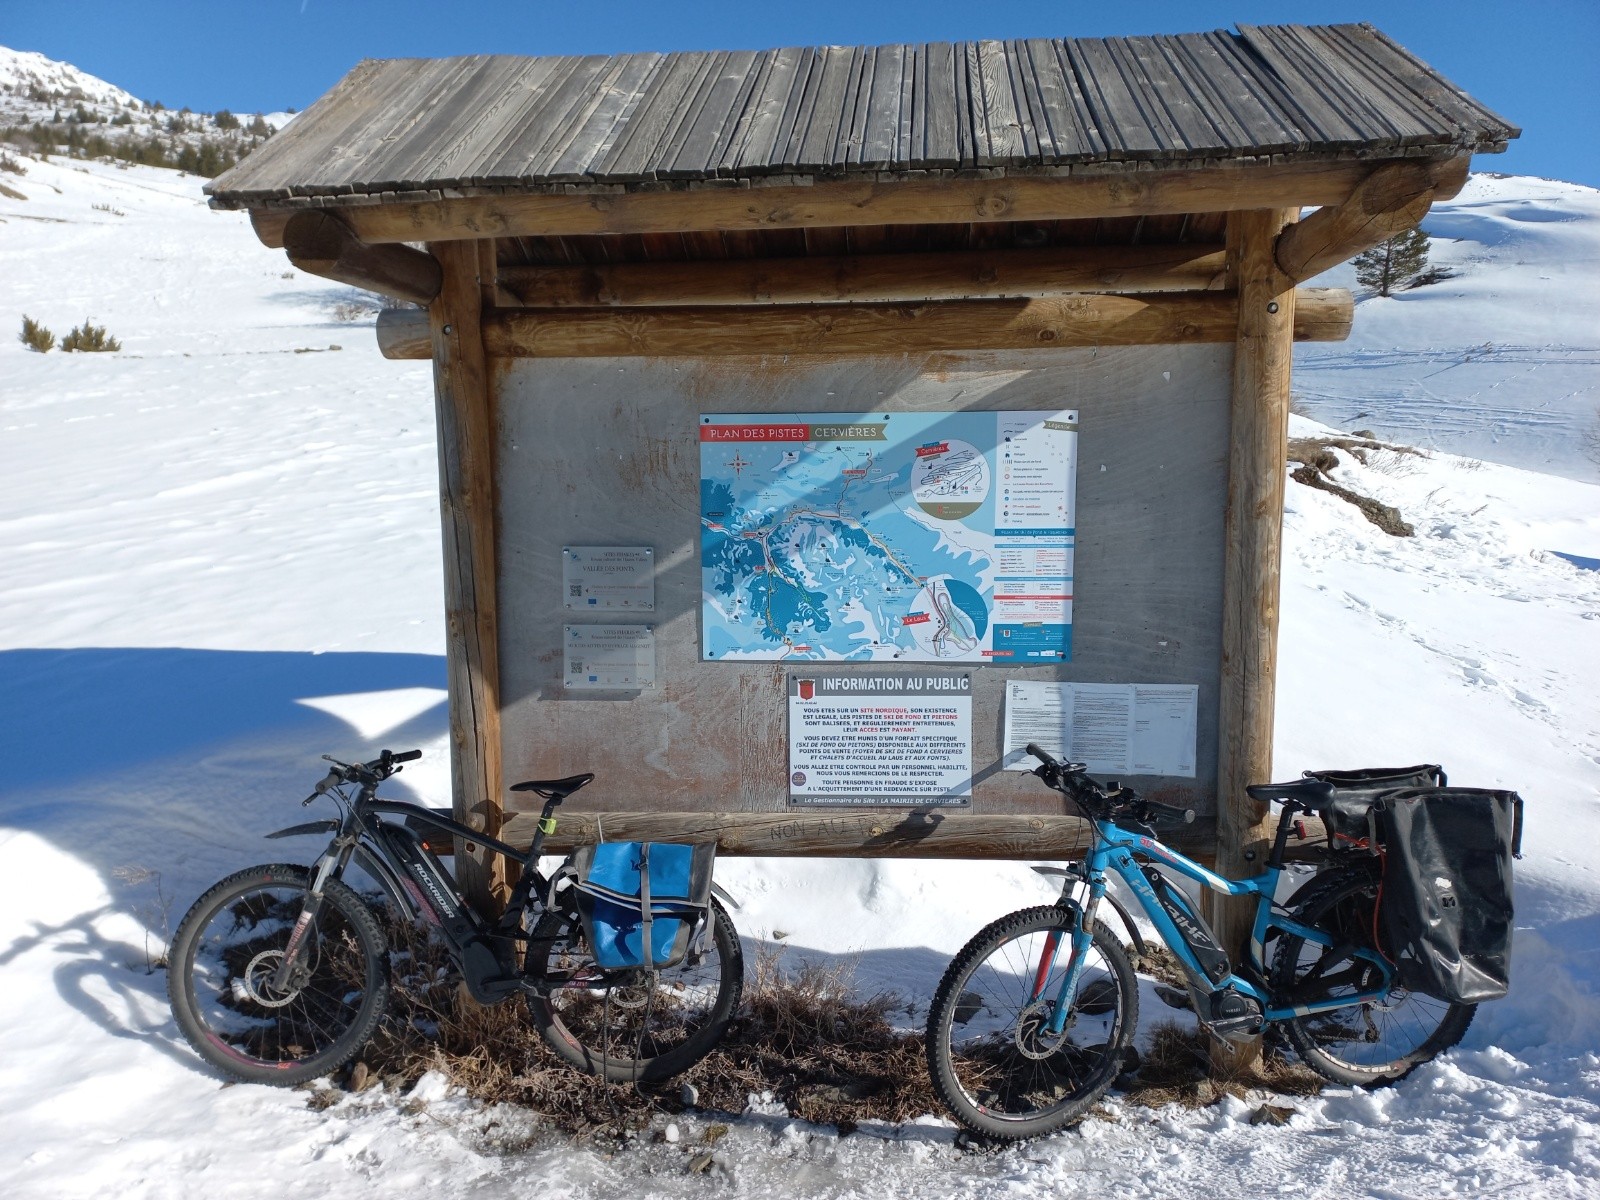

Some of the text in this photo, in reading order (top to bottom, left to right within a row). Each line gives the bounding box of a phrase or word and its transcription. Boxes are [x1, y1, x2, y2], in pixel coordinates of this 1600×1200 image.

[710, 426, 877, 438] PLAN DES PISTES CERVIÈRES
[823, 678, 969, 690] INFORMATION AU PUBLIC
[770, 820, 805, 841] NON
[817, 819, 846, 836] AU
[414, 863, 455, 918] ROCKRIDER
